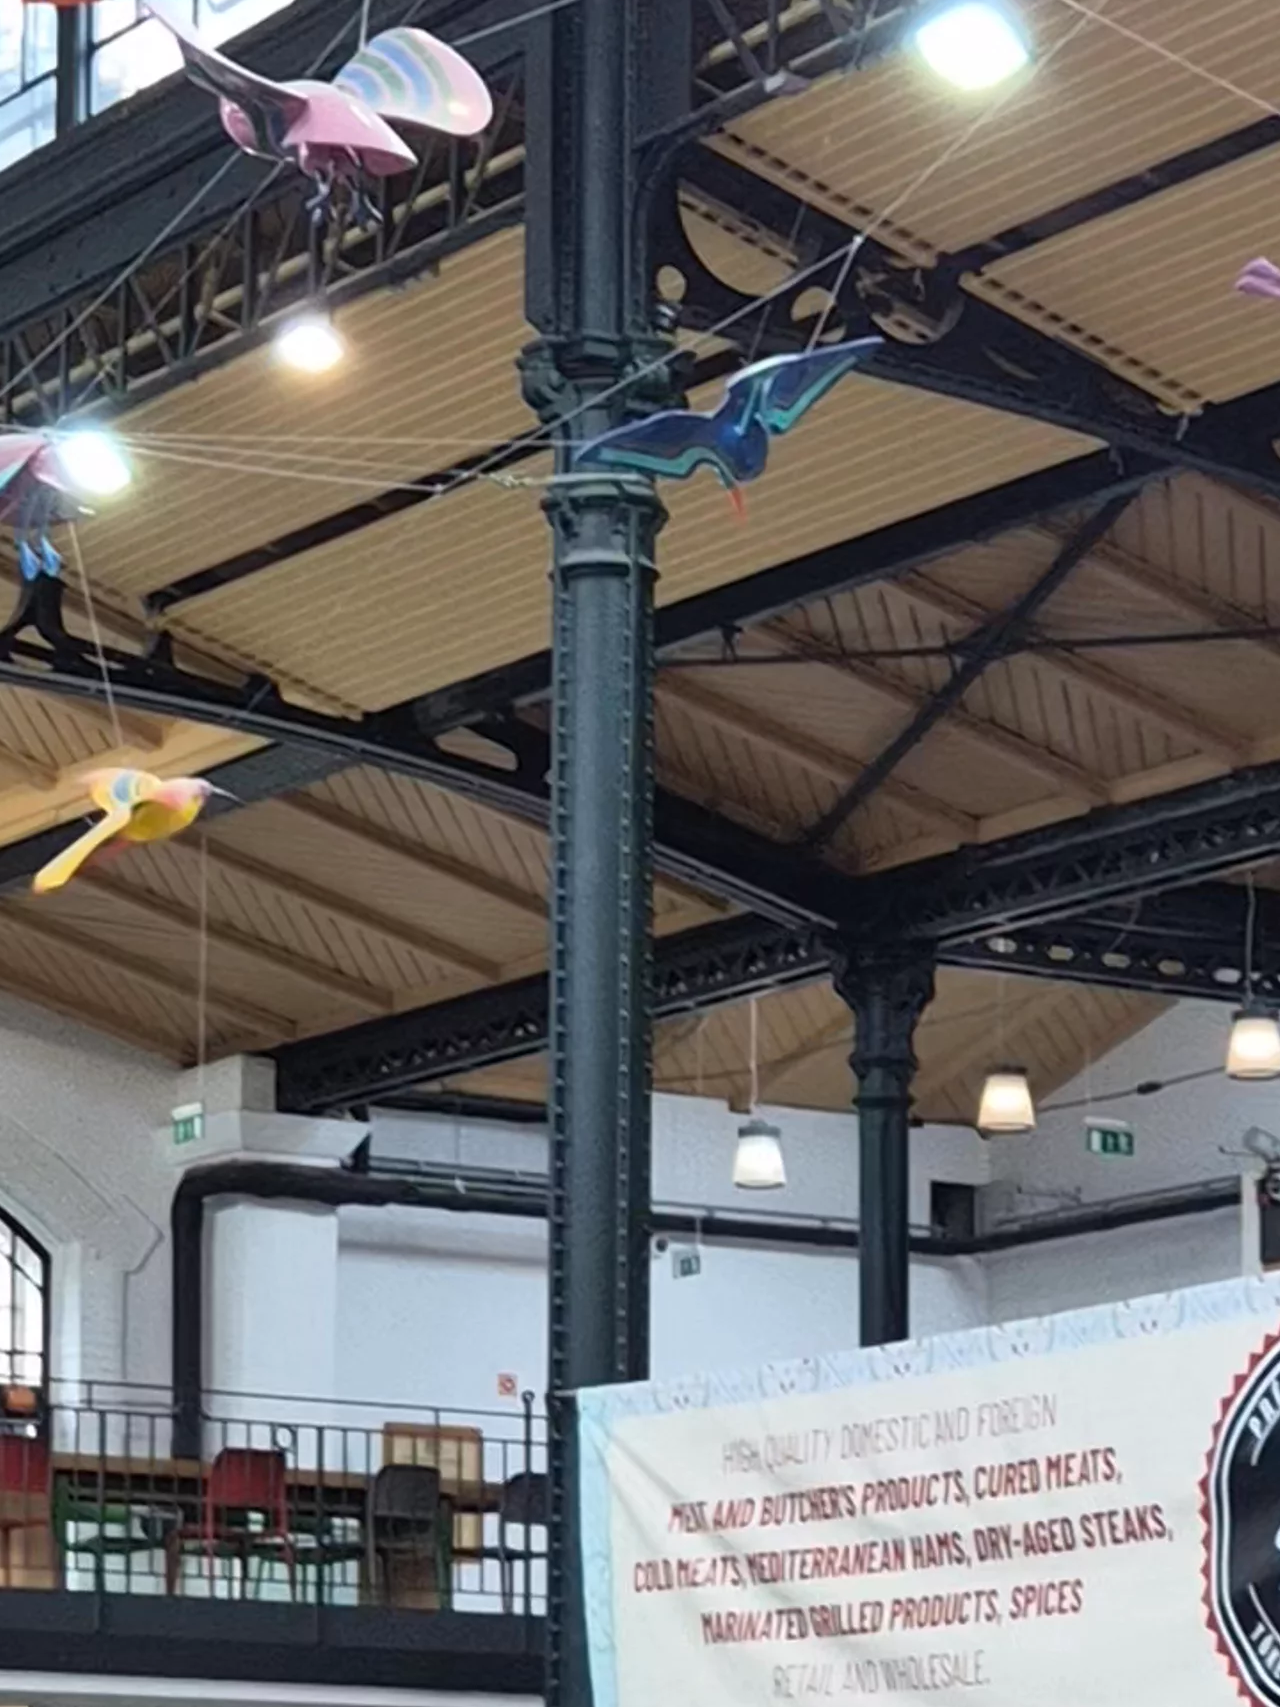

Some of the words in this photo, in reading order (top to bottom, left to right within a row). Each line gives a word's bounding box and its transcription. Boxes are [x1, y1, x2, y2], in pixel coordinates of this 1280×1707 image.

[764, 1429, 834, 1473] QUALITY
[840, 1412, 931, 1460] DOMESTIC
[934, 1406, 970, 1443] AND
[976, 1393, 1057, 1439] FOREIGN
[713, 1498, 756, 1531] AND
[861, 1470, 971, 1516] PRODUCTS,
[973, 1459, 1041, 1499] CURED
[1045, 1447, 1123, 1491] MEATS,
[634, 1559, 672, 1593] COLD
[677, 1554, 747, 1591] MEATS,
[745, 1537, 906, 1587] MEDITERRANEAN
[911, 1531, 972, 1569] HAMS,
[973, 1517, 1077, 1562] DRY-AGED
[1079, 1503, 1174, 1548] STEAKS,
[701, 1607, 809, 1647] MARINATED
[808, 1601, 883, 1639] GRILLED
[888, 1589, 1003, 1632] PRODUCTS,
[1008, 1578, 1085, 1621] SPICES
[772, 1662, 835, 1699] RETAIL
[842, 1657, 880, 1693] AND
[880, 1649, 992, 1693] WHOLESALE.
